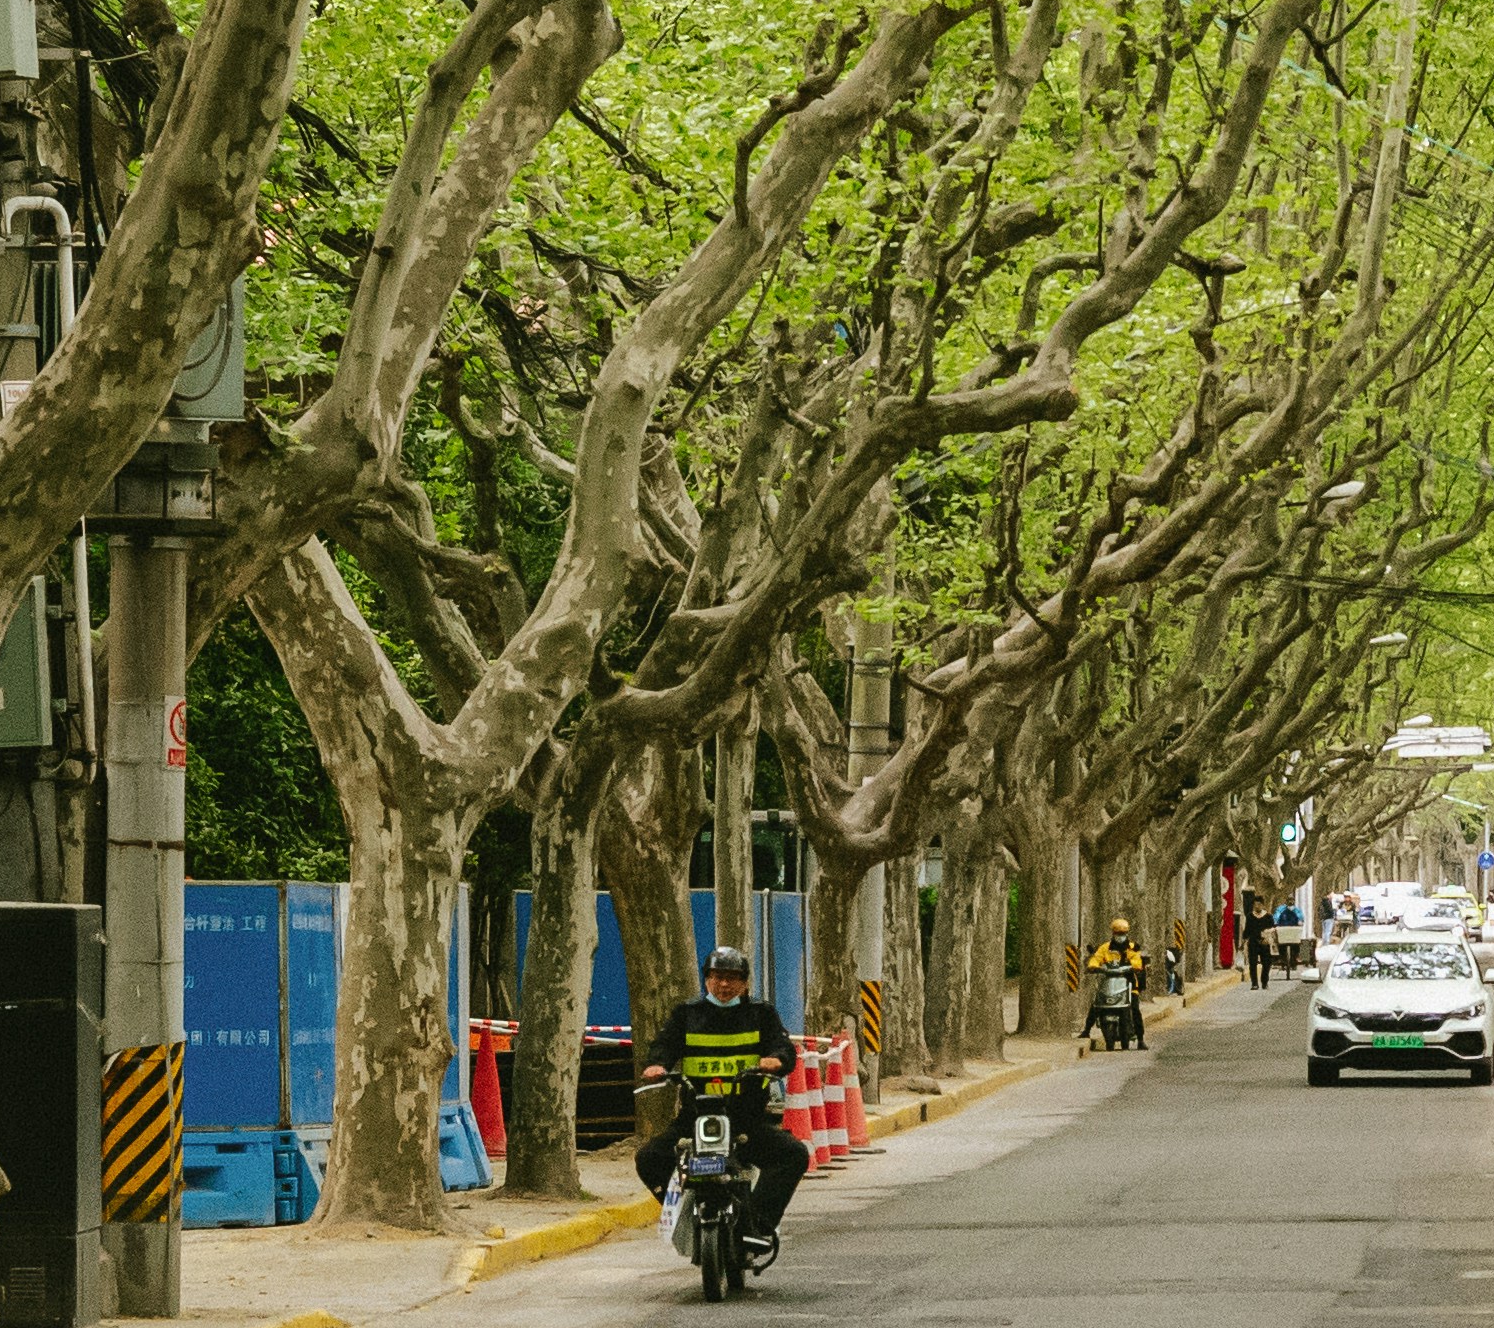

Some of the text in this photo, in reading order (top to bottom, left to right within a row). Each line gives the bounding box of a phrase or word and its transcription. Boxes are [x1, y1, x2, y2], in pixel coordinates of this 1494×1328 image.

[184, 1029, 270, 1047] 团）有限公司
